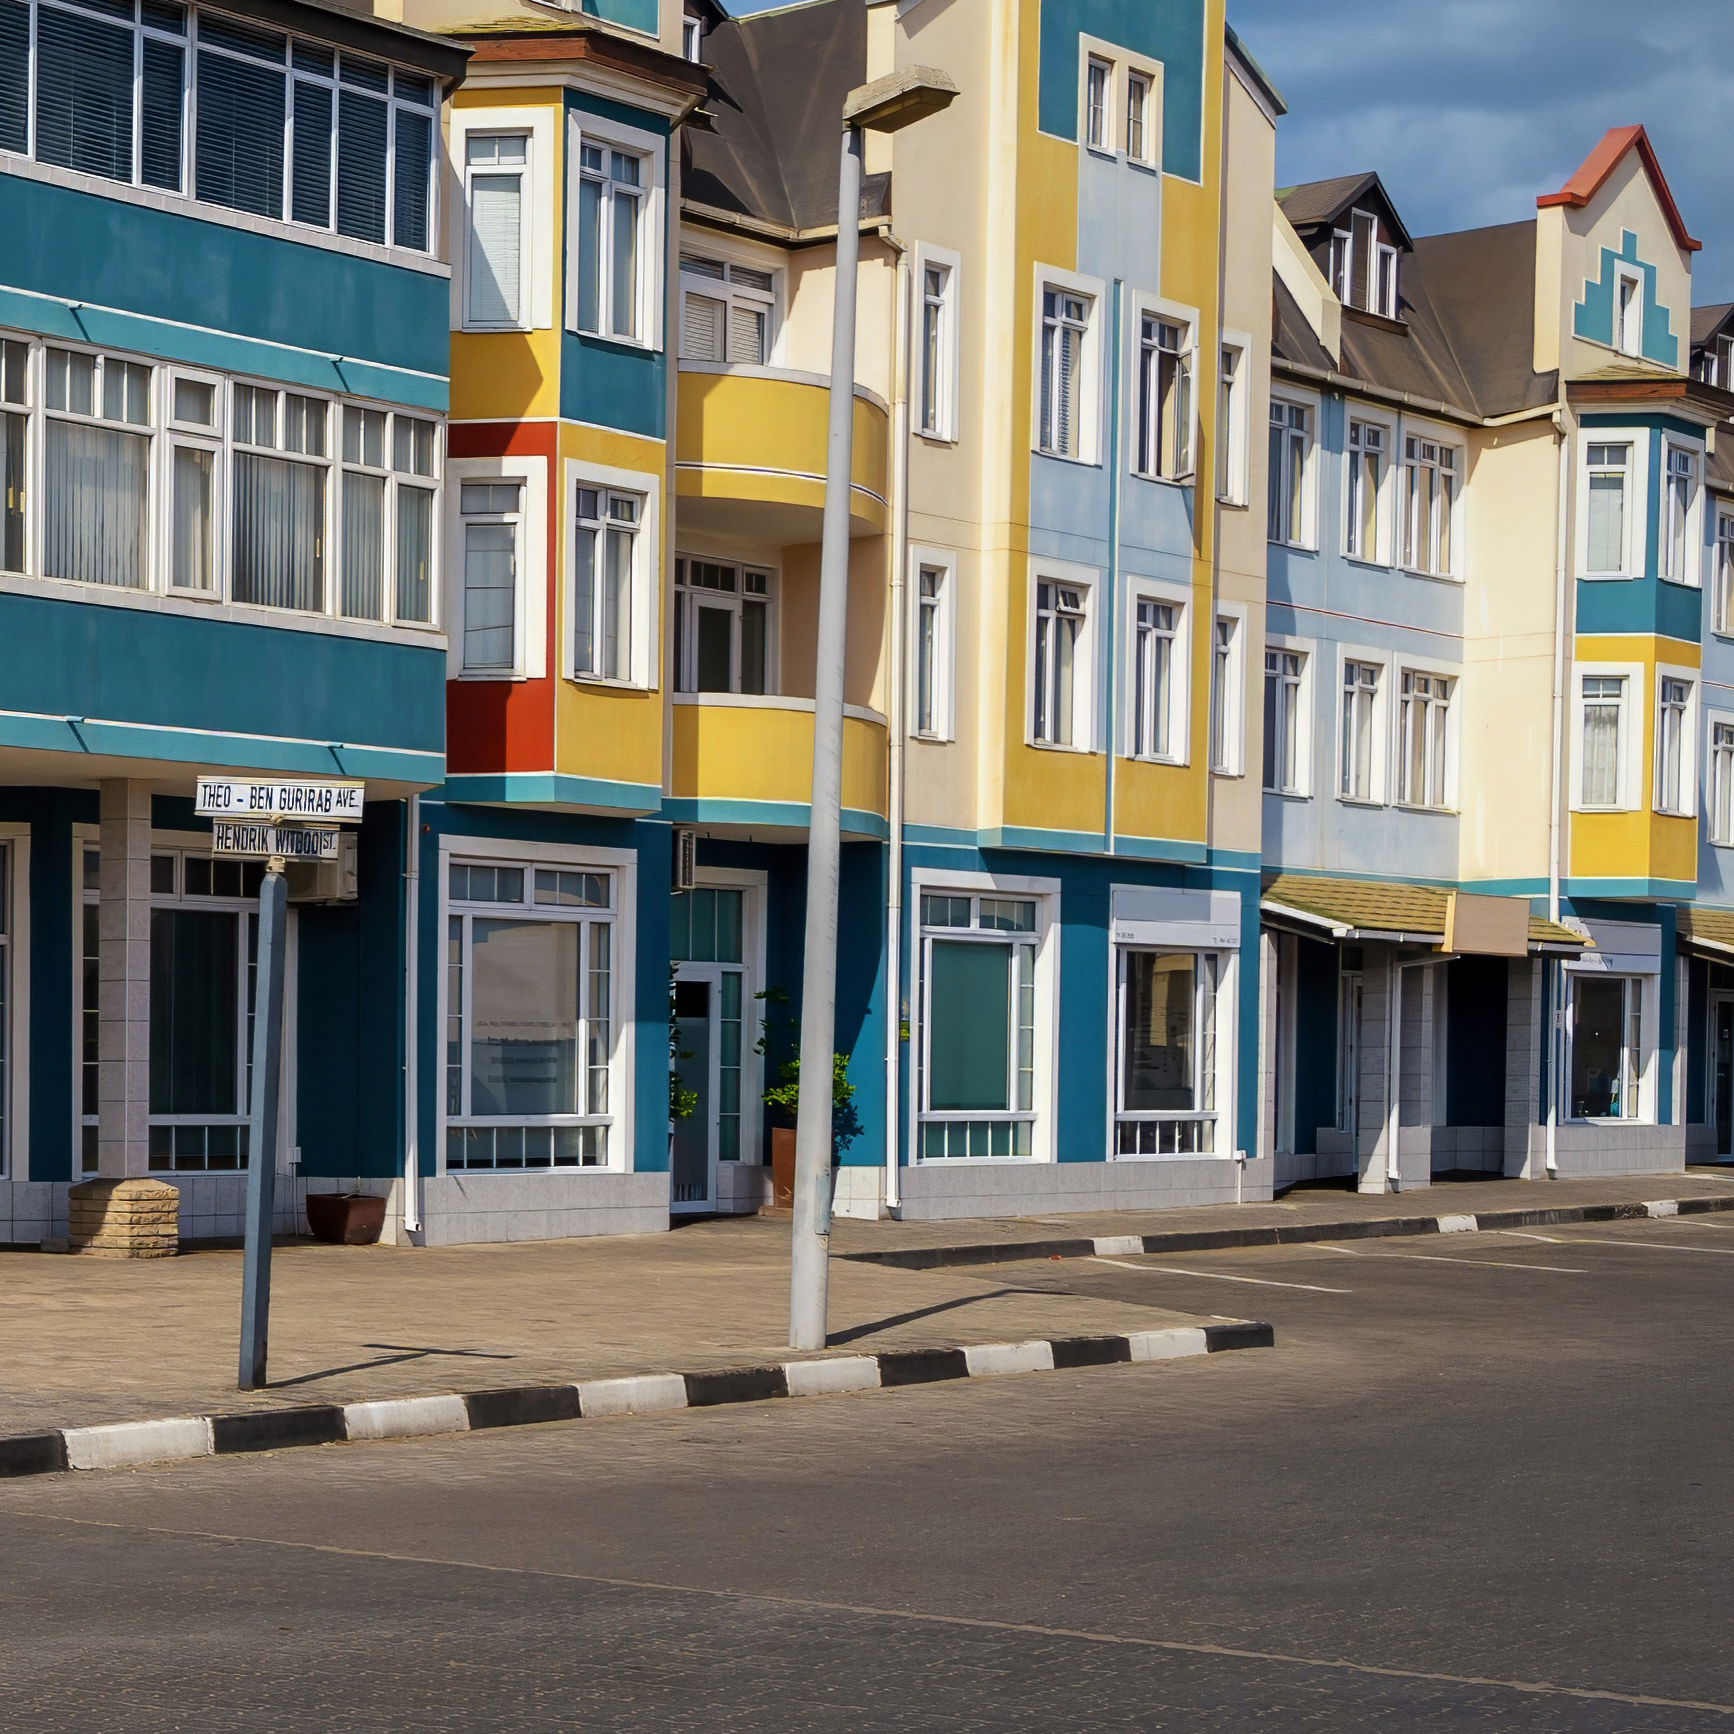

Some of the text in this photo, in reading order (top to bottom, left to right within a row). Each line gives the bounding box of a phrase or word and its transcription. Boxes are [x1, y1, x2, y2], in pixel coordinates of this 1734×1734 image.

[202, 784, 231, 808] THEO
[249, 786, 273, 810] BEN
[279, 788, 332, 813] GURIRAB
[216, 825, 269, 852] HENDRIK
